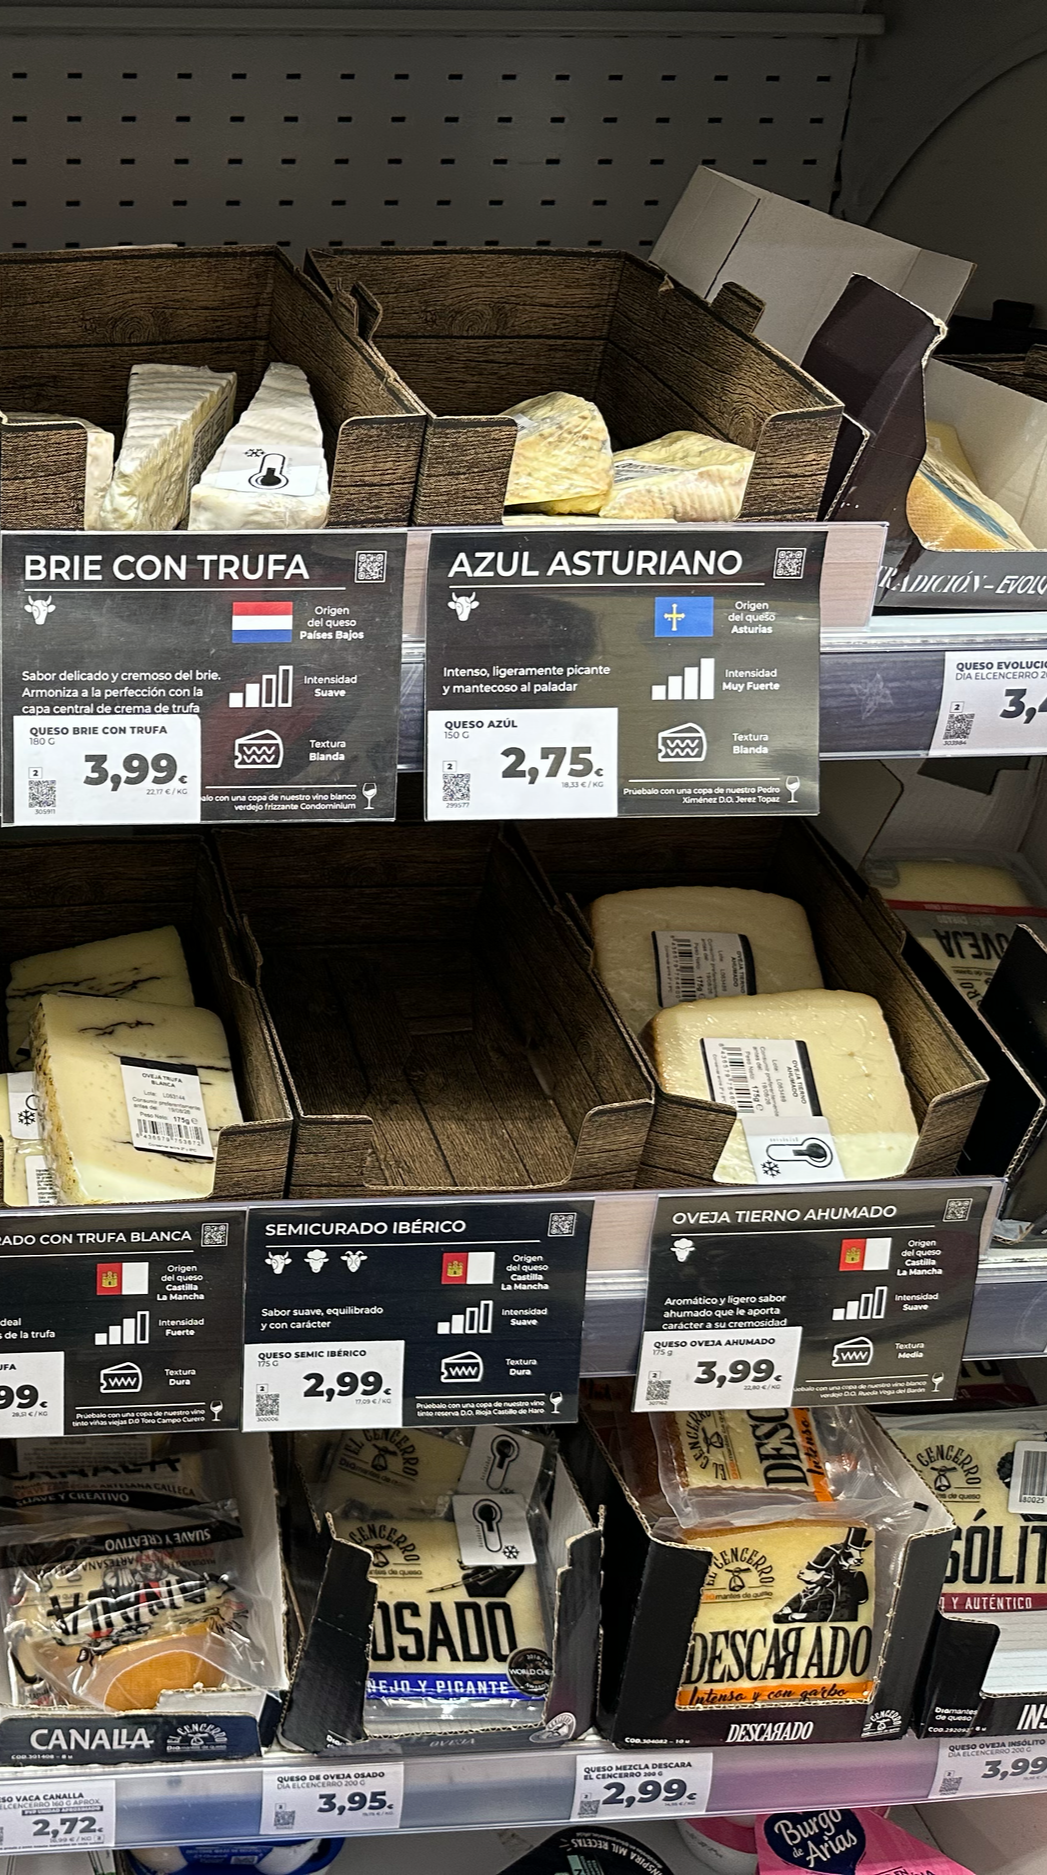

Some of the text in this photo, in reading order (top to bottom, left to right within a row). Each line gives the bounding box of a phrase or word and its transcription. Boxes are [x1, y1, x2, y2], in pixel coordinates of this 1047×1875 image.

[25, 554, 310, 580] BRIE CON TRUFA
[447, 550, 743, 577] AZUL ASTURIANO
[731, 624, 773, 634] Asturias
[300, 630, 364, 641] Países Bajos
[444, 665, 611, 678] Intenso, ligeramente picante
[956, 662, 994, 672] QUESO
[22, 670, 221, 683] Sabor delicado y cremoso del brie.
[974, 671, 1039, 680] ELCENCERRO
[442, 681, 578, 695] y mantecoso al paladar
[722, 682, 780, 692] Muy Fuerte
[30, 726, 167, 737] QUESO BRIE CON TRUFA
[444, 720, 484, 731] QUESO
[672, 1205, 897, 1224] OVEJA TIERNO AHUMADO
[265, 1219, 466, 1236] SEMICURADO IBÉRICO
[40, 1234, 73, 1245] CON
[76, 1232, 127, 1243] TRUFA
[131, 1231, 192, 1242] BLANCA
[166, 1283, 198, 1291] Castilla
[260, 1323, 267, 1331] y
[290, 1320, 331, 1329] carácter
[654, 1341, 688, 1349] QUESO
[724, 1338, 776, 1346] AHUMADO
[258, 1352, 292, 1361] QUESO
[327, 1349, 367, 1357] IBÉRICO
[415, 1679, 509, 1694] Y PICANTE
[949, 1744, 977, 1752] QUESO
[1008, 1739, 1046, 1747] INSÓLITO
[584, 1765, 613, 1774] QUESO
[615, 1763, 650, 1771] MEZCLA
[277, 1775, 307, 1784] QUESO
[354, 1771, 385, 1779] OSADO
[43, 1792, 84, 1801] CANALLA
[806, 1829, 859, 1868] Arias
